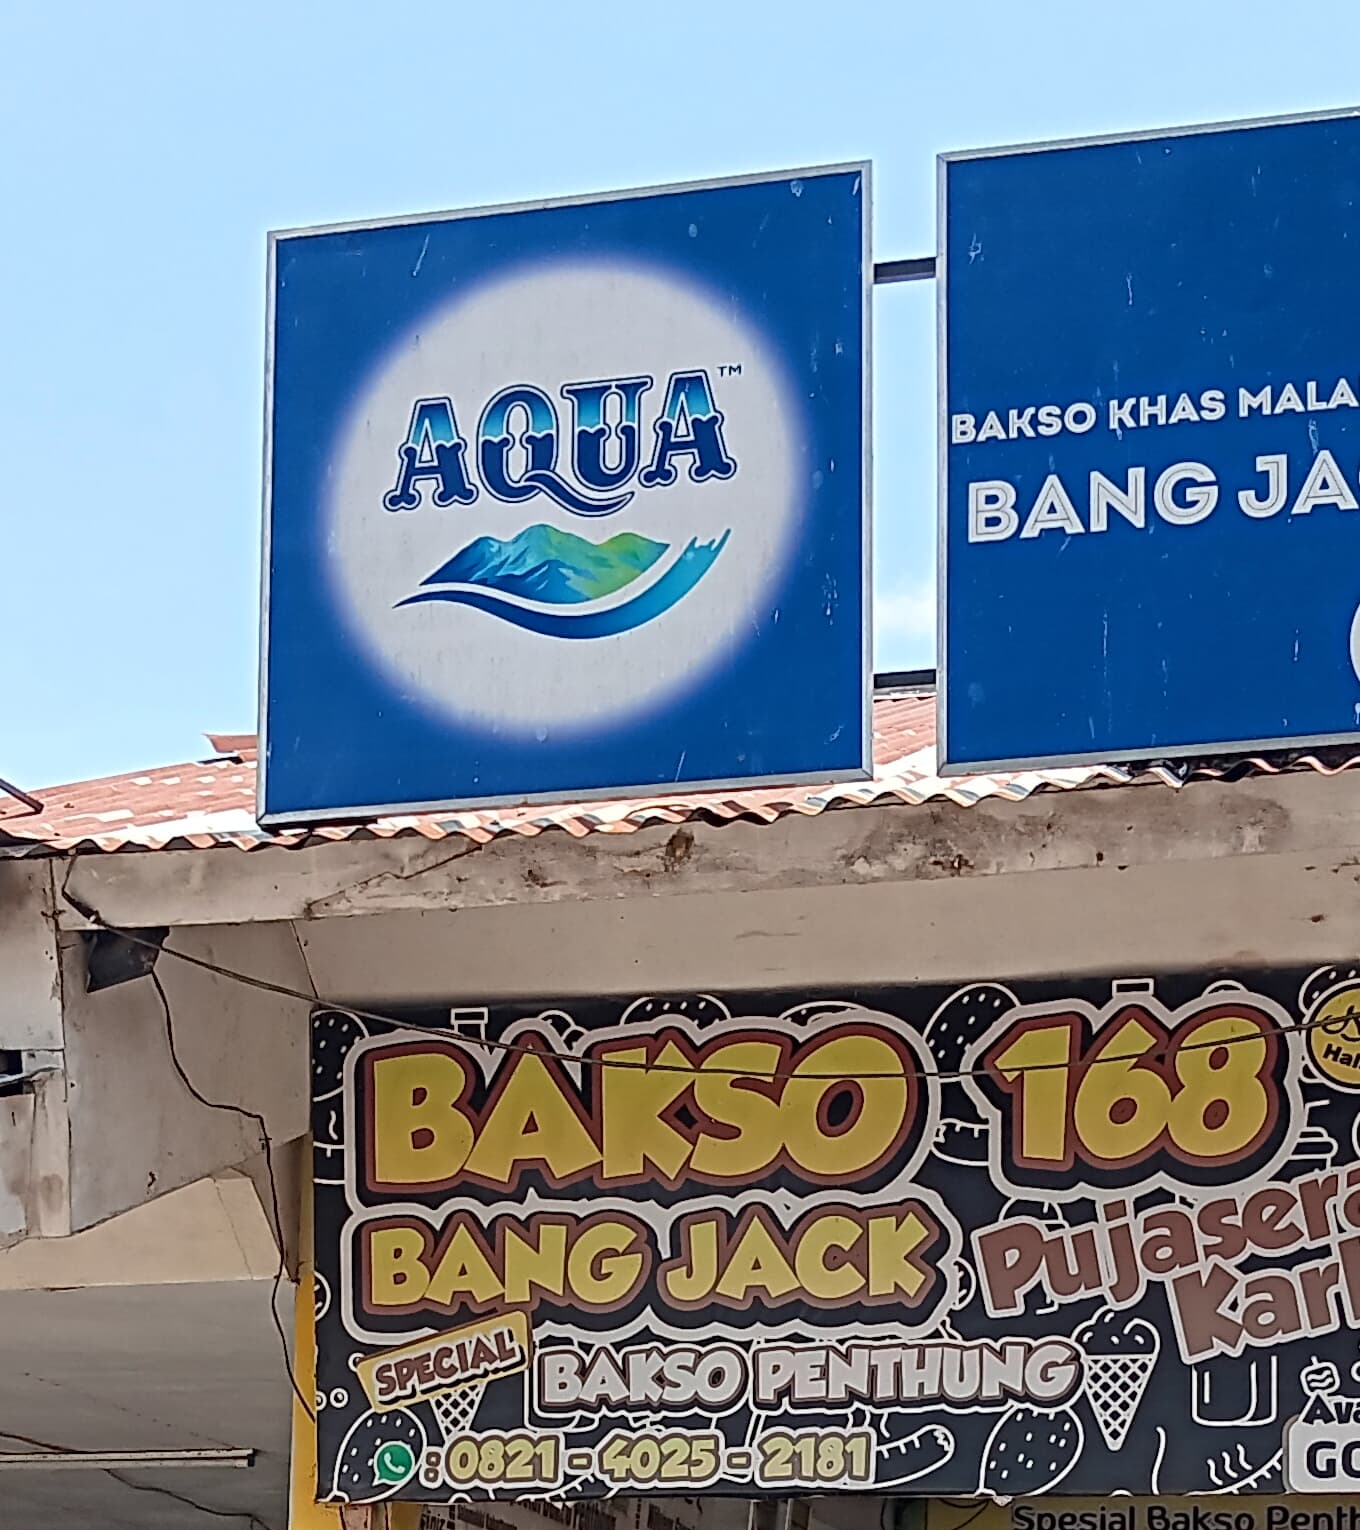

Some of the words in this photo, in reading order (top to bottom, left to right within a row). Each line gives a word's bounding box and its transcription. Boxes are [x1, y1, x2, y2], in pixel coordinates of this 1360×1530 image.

[383, 369, 736, 517] AQUA
[950, 400, 1097, 445] BAKSO
[1108, 388, 1226, 432] KHAS
[966, 460, 1220, 545] BANG
[363, 1022, 919, 1192] BAKSO
[987, 1009, 1280, 1173] 168
[360, 1206, 652, 1315] BANG
[659, 1199, 947, 1312] JACK
[373, 1330, 521, 1402] SPECIAL
[541, 1348, 748, 1408] BAKSO
[755, 1340, 1080, 1409] PENTHUNG
[444, 1433, 561, 1485] 0821
[601, 1433, 718, 1483] 4025
[757, 1431, 876, 1483] 2181
